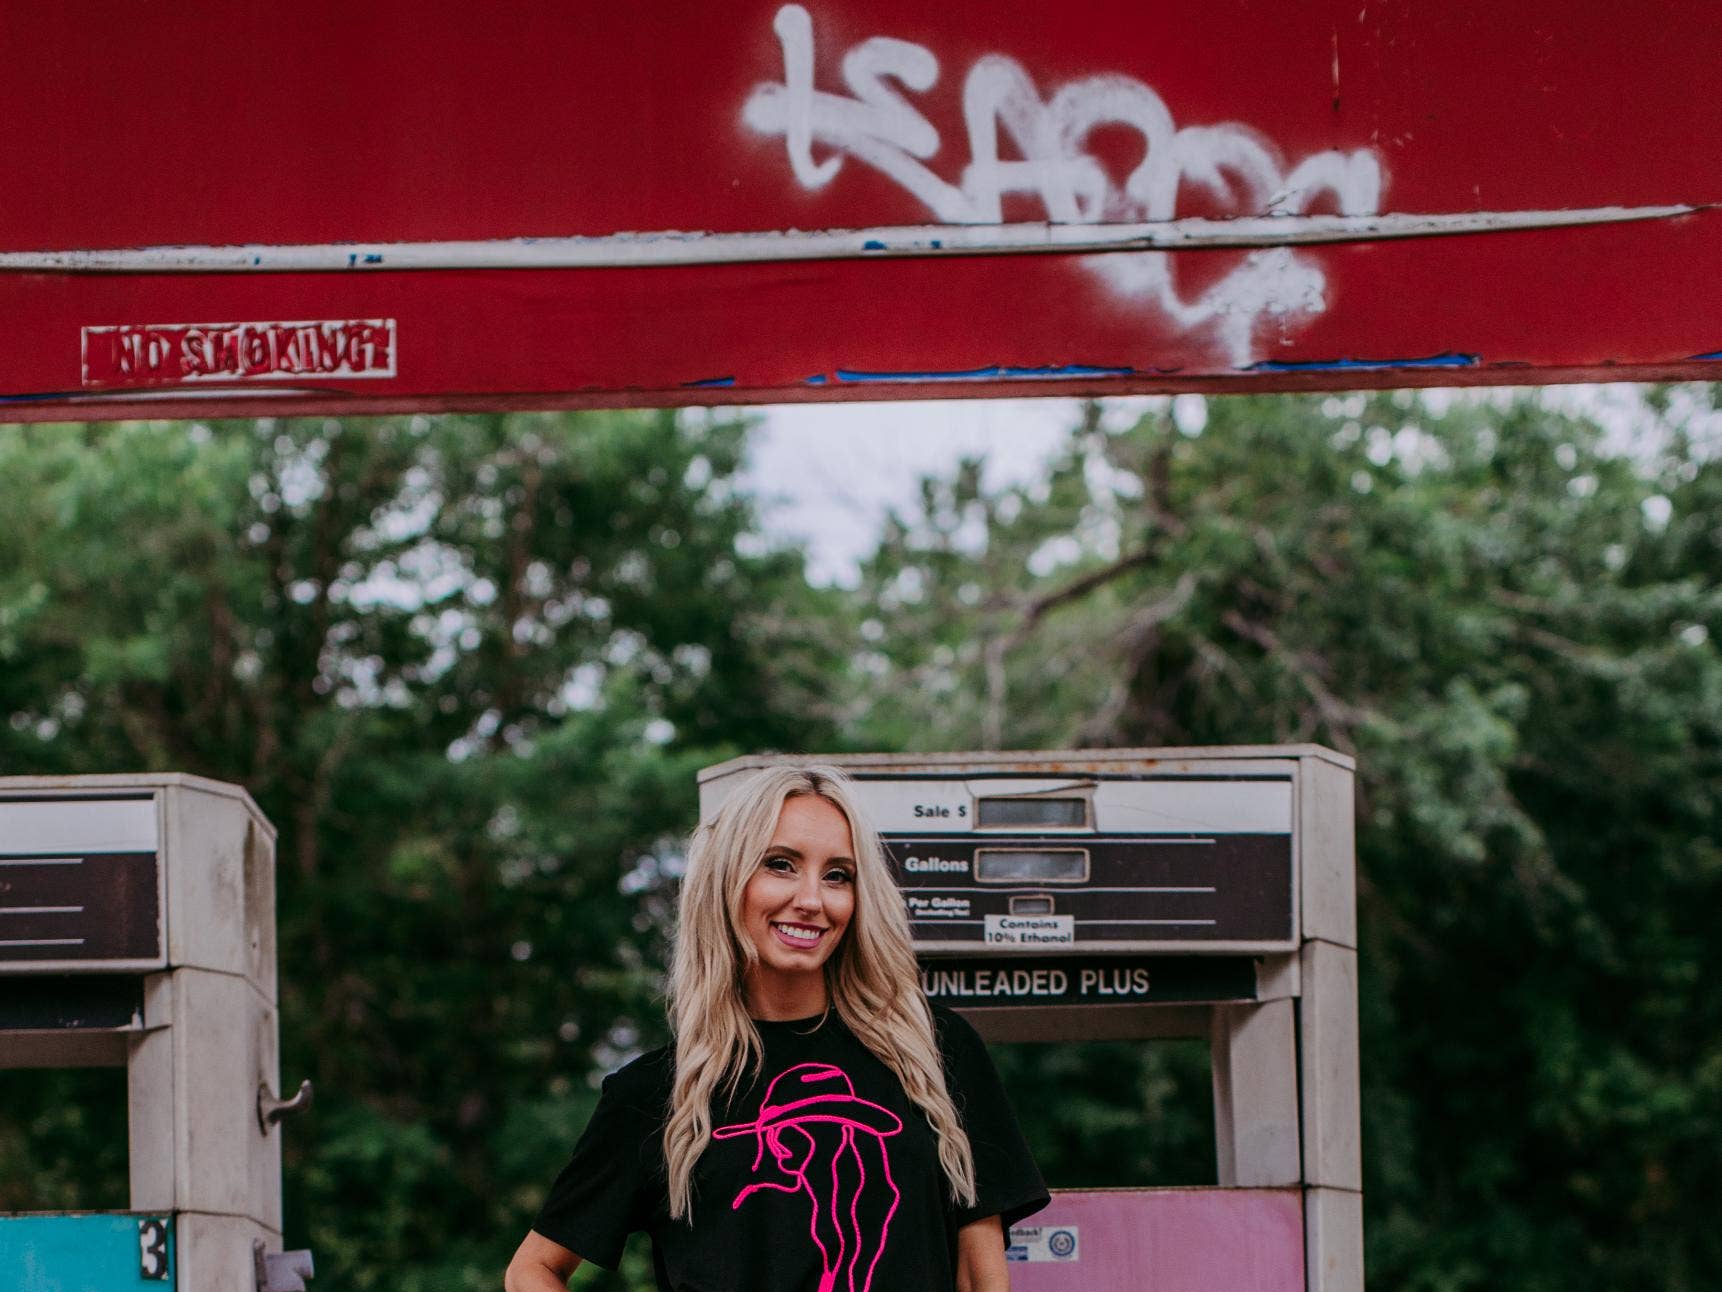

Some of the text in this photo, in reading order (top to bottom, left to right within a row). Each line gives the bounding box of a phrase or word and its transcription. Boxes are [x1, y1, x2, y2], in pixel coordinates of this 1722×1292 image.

[112, 325, 387, 374] NO SMOKING
[914, 804, 967, 818] Sale $
[905, 857, 969, 872] Gallons
[999, 918, 1058, 929] Contains
[988, 931, 1072, 943] 10% Ethanol
[922, 969, 1150, 996] UNLEADED PLUS
[140, 1219, 168, 1279] 3
